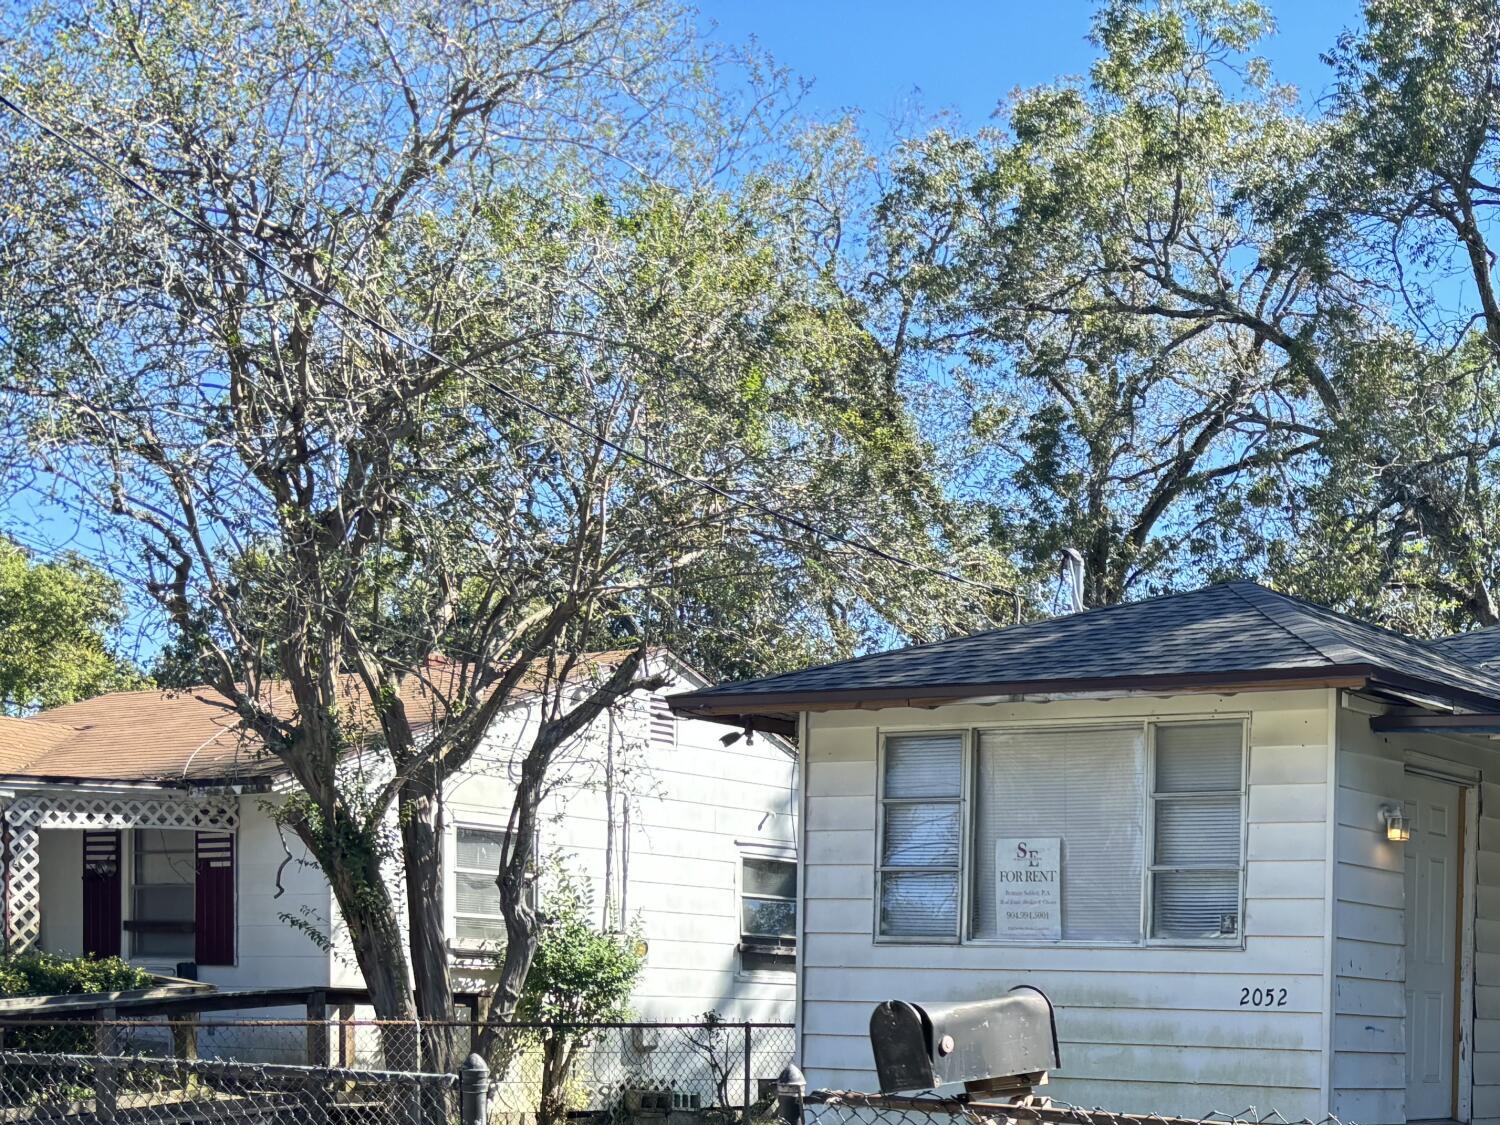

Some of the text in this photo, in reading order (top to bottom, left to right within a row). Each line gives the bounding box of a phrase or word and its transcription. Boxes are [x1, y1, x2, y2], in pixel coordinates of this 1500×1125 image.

[1000, 870, 1057, 883] FOR RENT
[1240, 987, 1288, 1007] 2052
